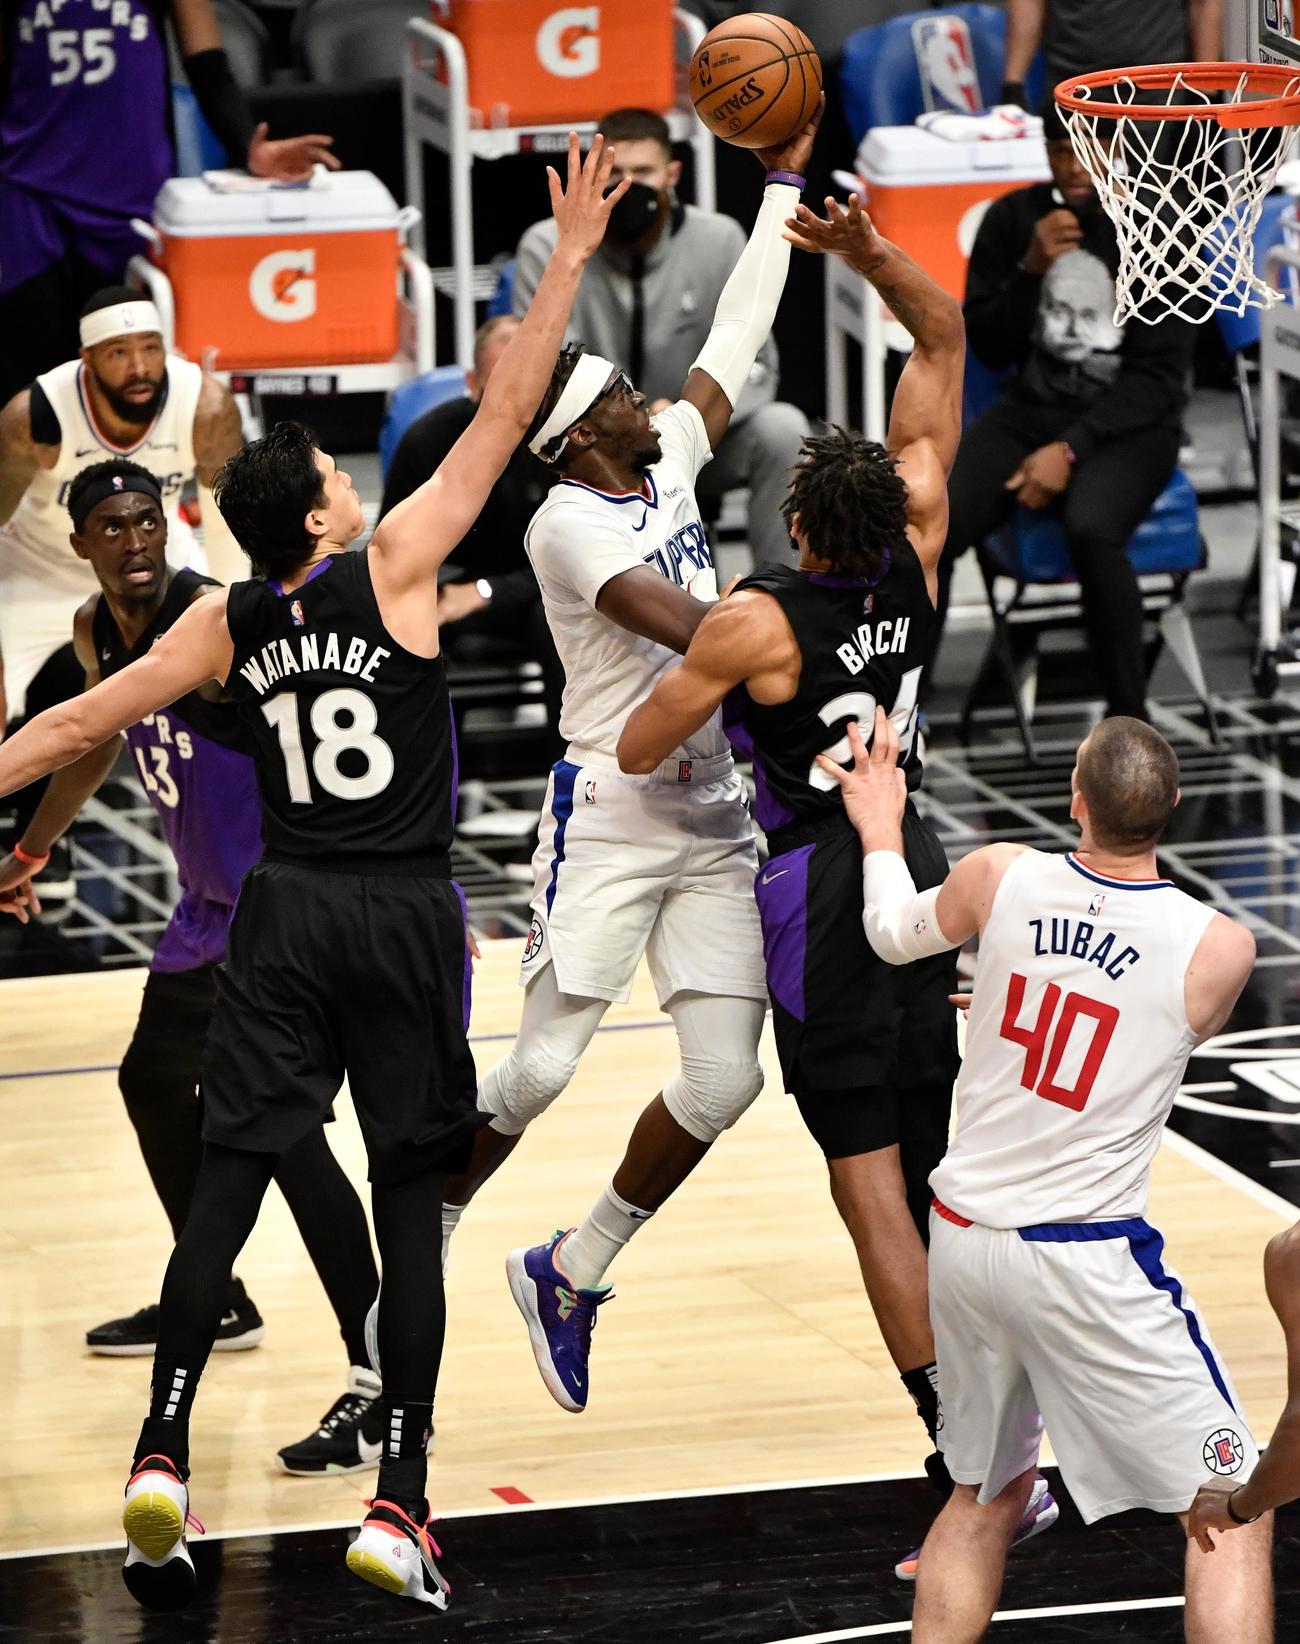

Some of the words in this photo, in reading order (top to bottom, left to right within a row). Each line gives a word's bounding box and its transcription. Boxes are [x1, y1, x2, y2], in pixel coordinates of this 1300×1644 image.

[18, 0, 149, 43] RARS
[536, 5, 599, 78] G
[47, 28, 116, 86] 55
[708, 77, 765, 123] SPALD
[249, 248, 316, 323] G
[239, 632, 392, 696] WATANABE
[260, 687, 395, 805] 18
[1029, 917, 1140, 981] ZUBAC
[1000, 972, 1120, 1113] 40
